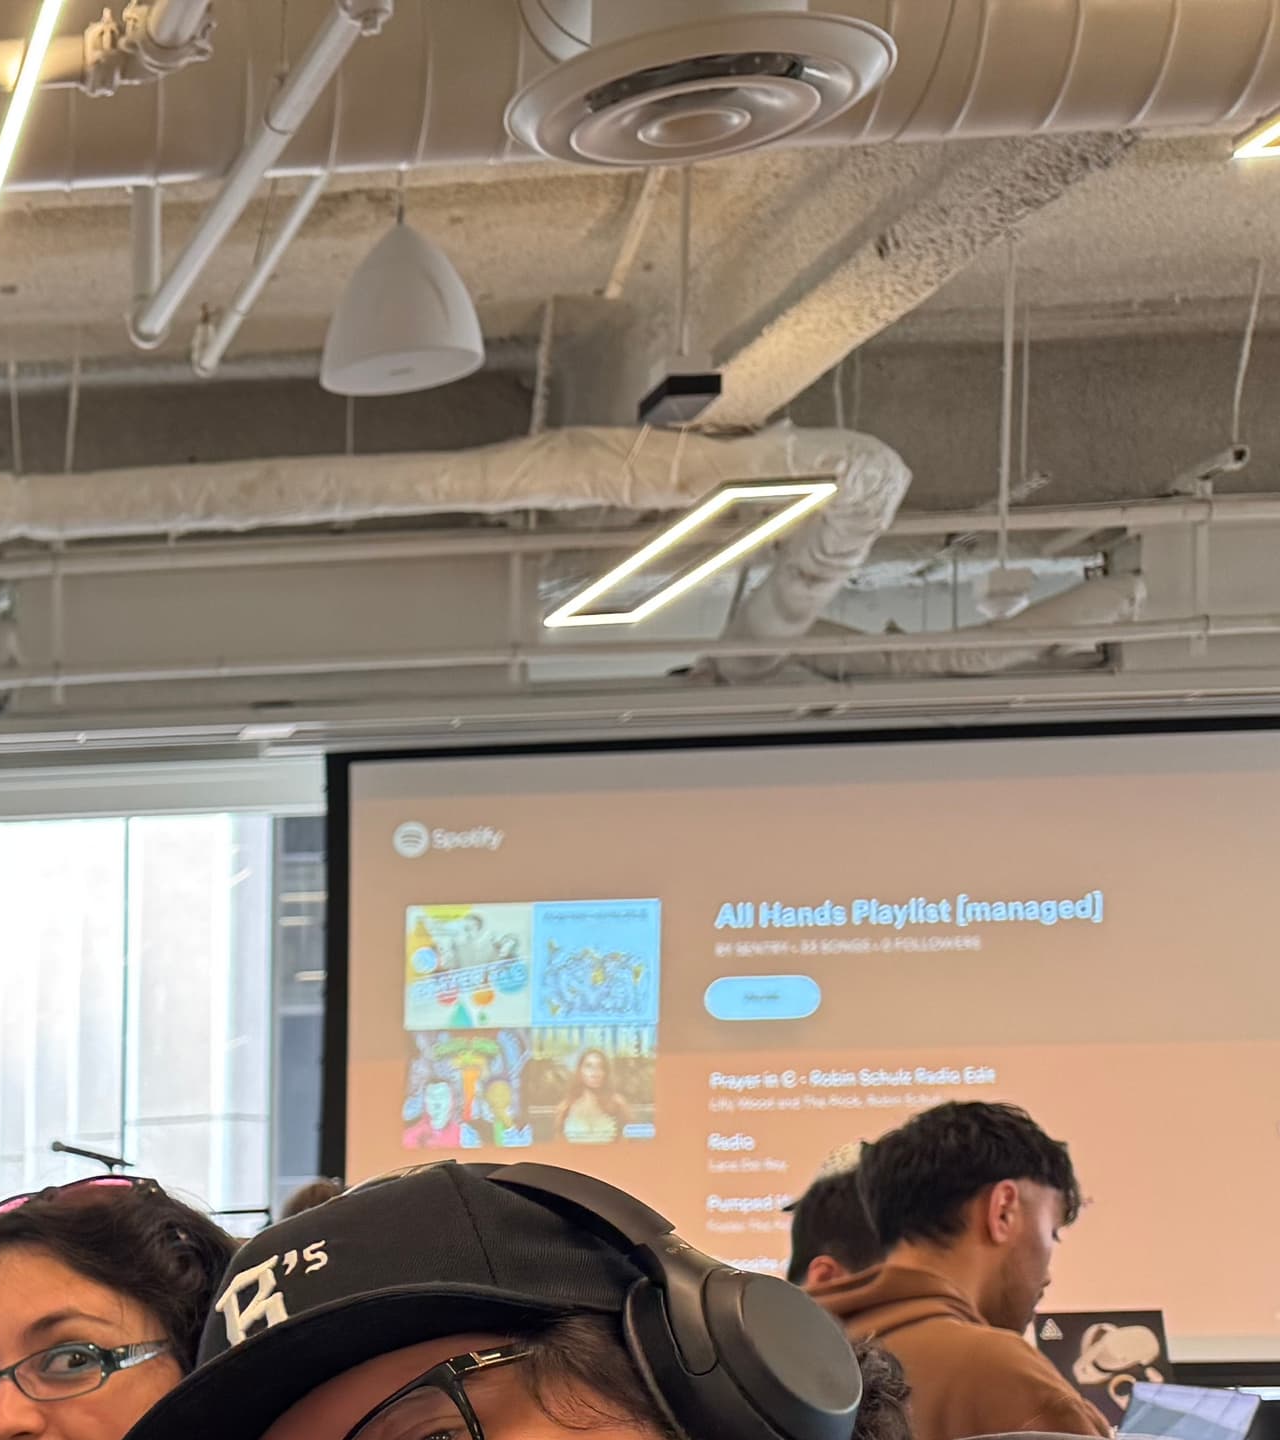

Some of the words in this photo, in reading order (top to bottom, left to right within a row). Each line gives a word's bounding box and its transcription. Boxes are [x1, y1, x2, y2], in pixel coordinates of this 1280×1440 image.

[432, 826, 504, 851] Spotify
[714, 902, 754, 928] All
[760, 900, 847, 928] Hands
[851, 897, 950, 930] Playlist
[957, 891, 1103, 926] [managed]
[709, 1072, 763, 1091] Prayer
[809, 1069, 856, 1087] Robin
[915, 1067, 961, 1085] Radio
[963, 1066, 996, 1083] Edit
[707, 1133, 755, 1151] Radio
